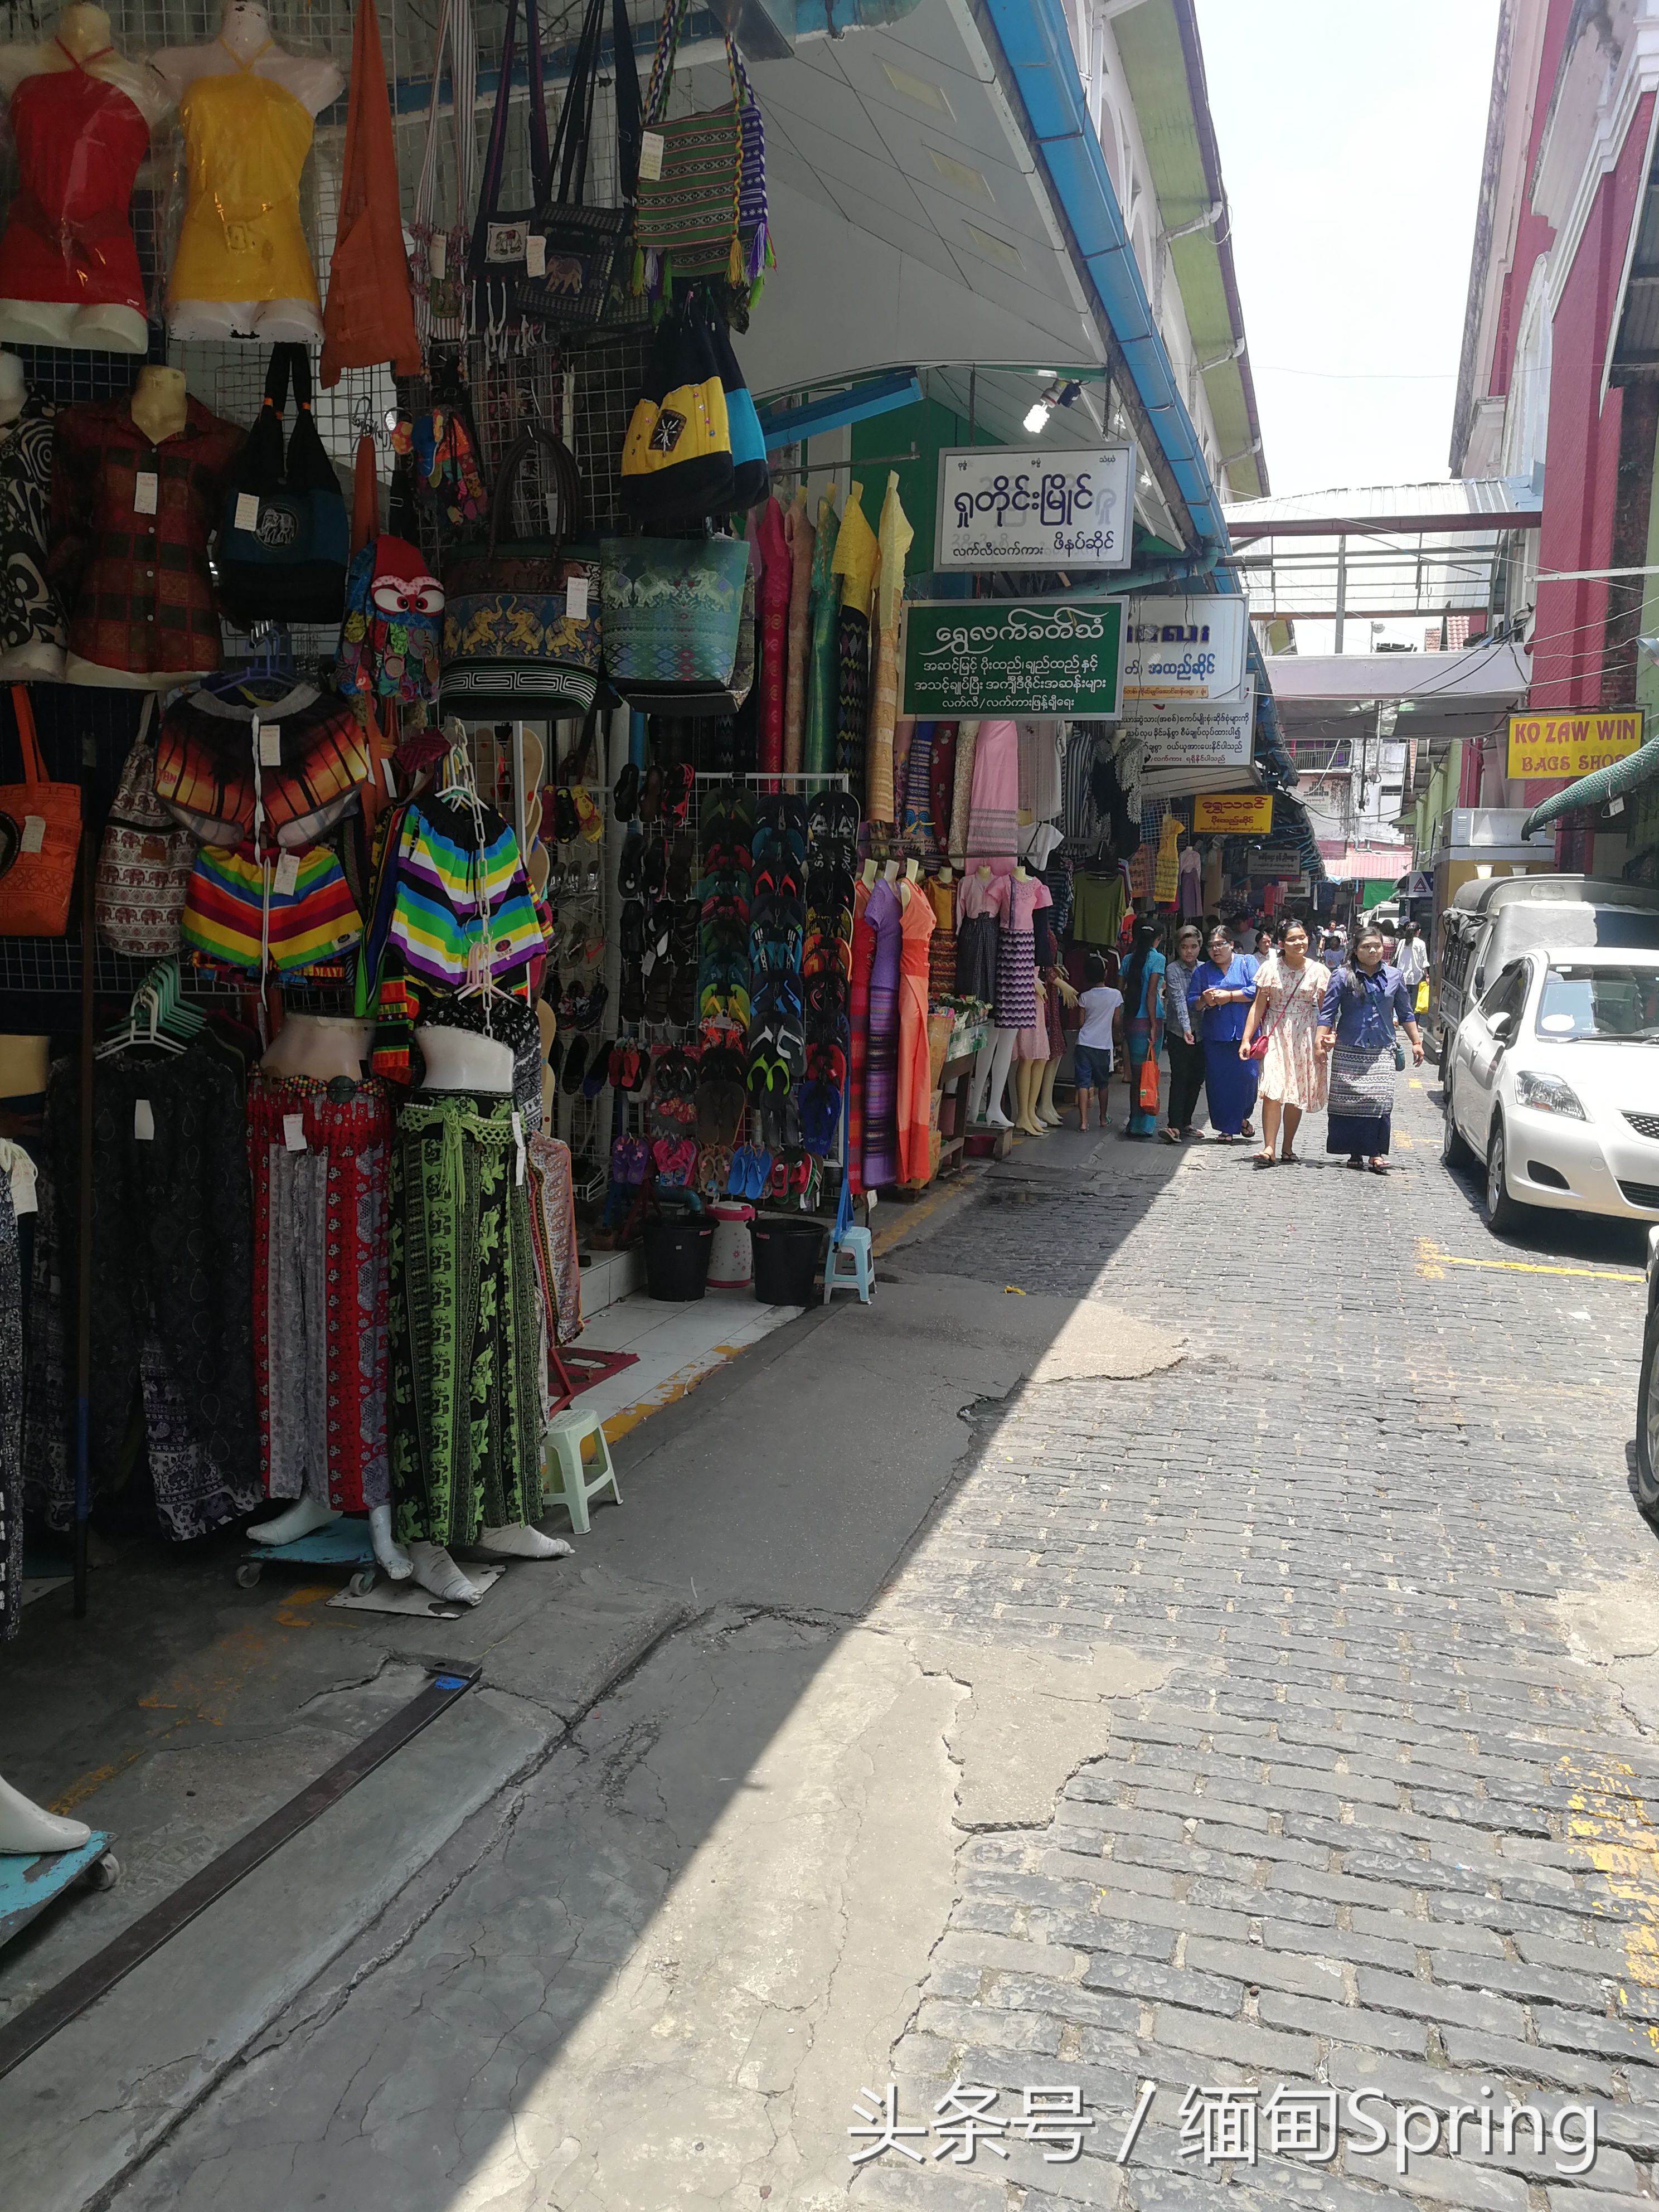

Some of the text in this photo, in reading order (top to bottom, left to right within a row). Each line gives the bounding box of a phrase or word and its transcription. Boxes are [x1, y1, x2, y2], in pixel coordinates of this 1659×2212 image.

[1054, 530, 1114, 557] ဖိနပ်ဆိုင်
[1148, 653, 1215, 681] အထည်ဆိုင်
[1515, 719, 1636, 745] KO ZAW WIN
[1521, 756, 1571, 772] BAGS
